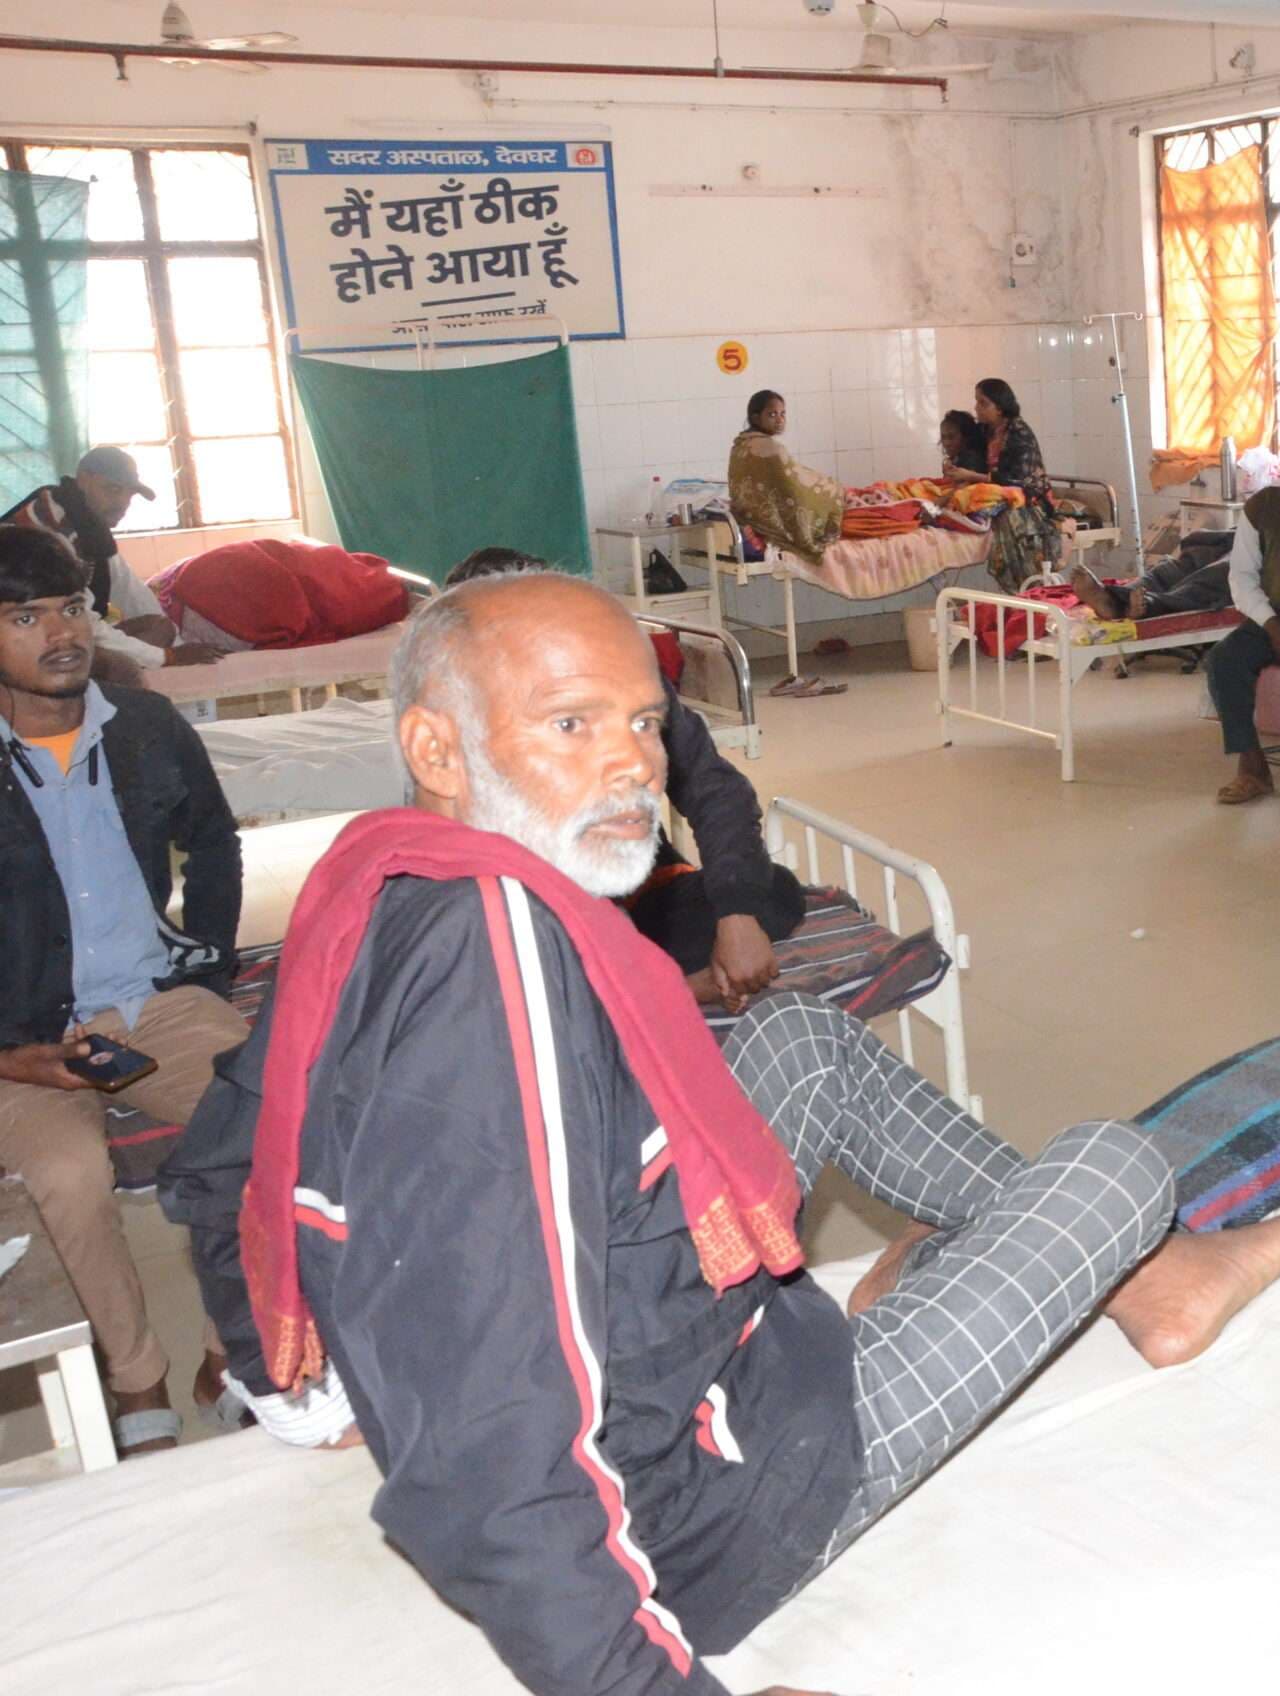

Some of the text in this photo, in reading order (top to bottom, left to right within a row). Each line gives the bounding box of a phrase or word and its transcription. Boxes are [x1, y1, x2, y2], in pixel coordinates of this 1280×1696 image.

[327, 145, 558, 167] सदर अस्पताल, देवघर
[324, 176, 560, 239] मैं यहाँ ठीक
[425, 242, 531, 285] आया
[537, 222, 580, 289] हूँ
[722, 348, 742, 371] 5
